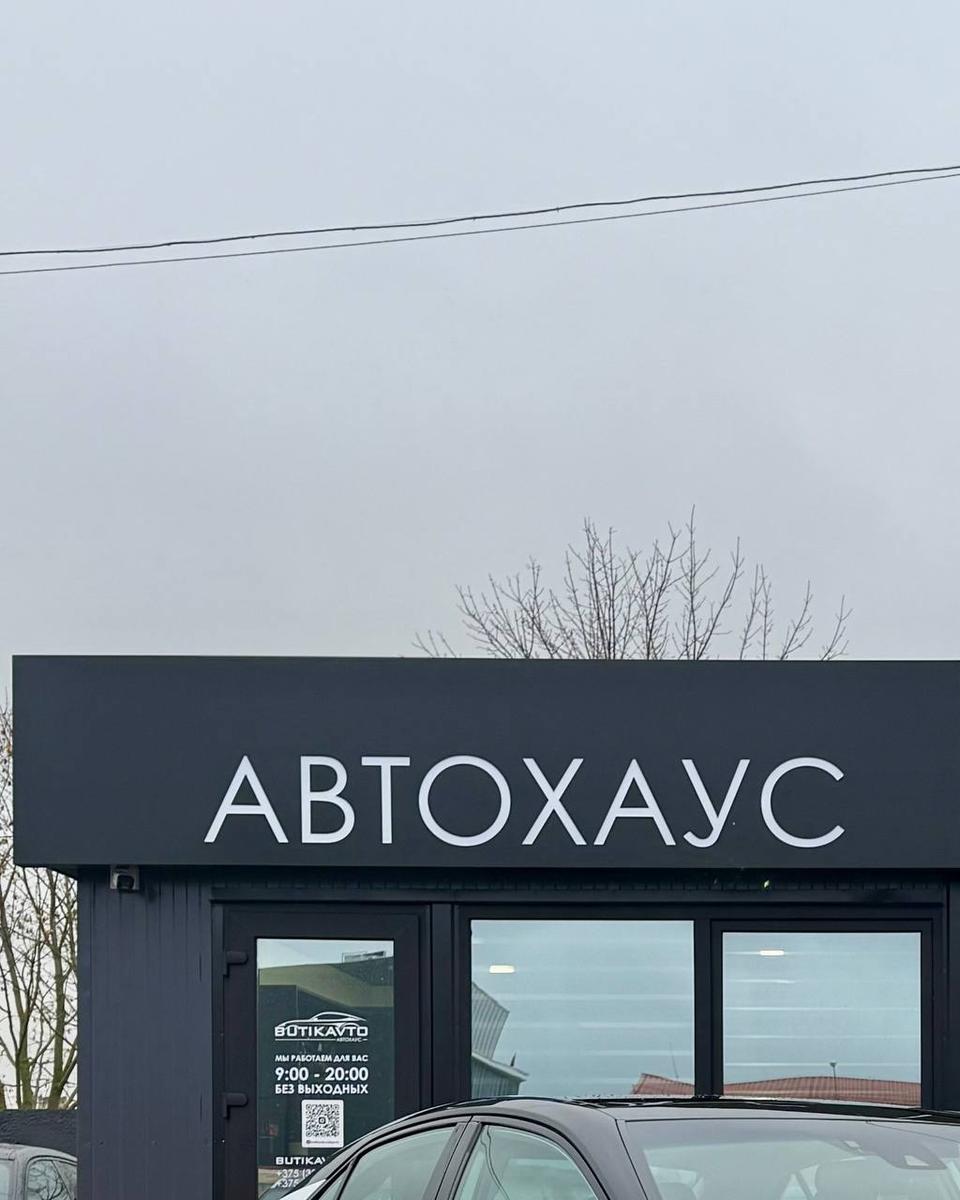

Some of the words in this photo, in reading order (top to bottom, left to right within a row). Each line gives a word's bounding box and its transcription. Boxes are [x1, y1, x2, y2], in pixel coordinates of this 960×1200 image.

[203, 754, 845, 848] АВТОХАУС
[274, 1026, 369, 1037] BUTIKAVTO
[275, 1054, 289, 1062] МЫ
[291, 1054, 332, 1062] РАБОТАЕМ
[333, 1054, 350, 1063] ДЛЯ
[351, 1054, 369, 1062] ВАС
[275, 1066, 309, 1081] 9:00
[324, 1066, 369, 1081] 20:00
[275, 1083, 295, 1095] БЕЗ
[297, 1083, 369, 1096] ВЫХОДНЫХ
